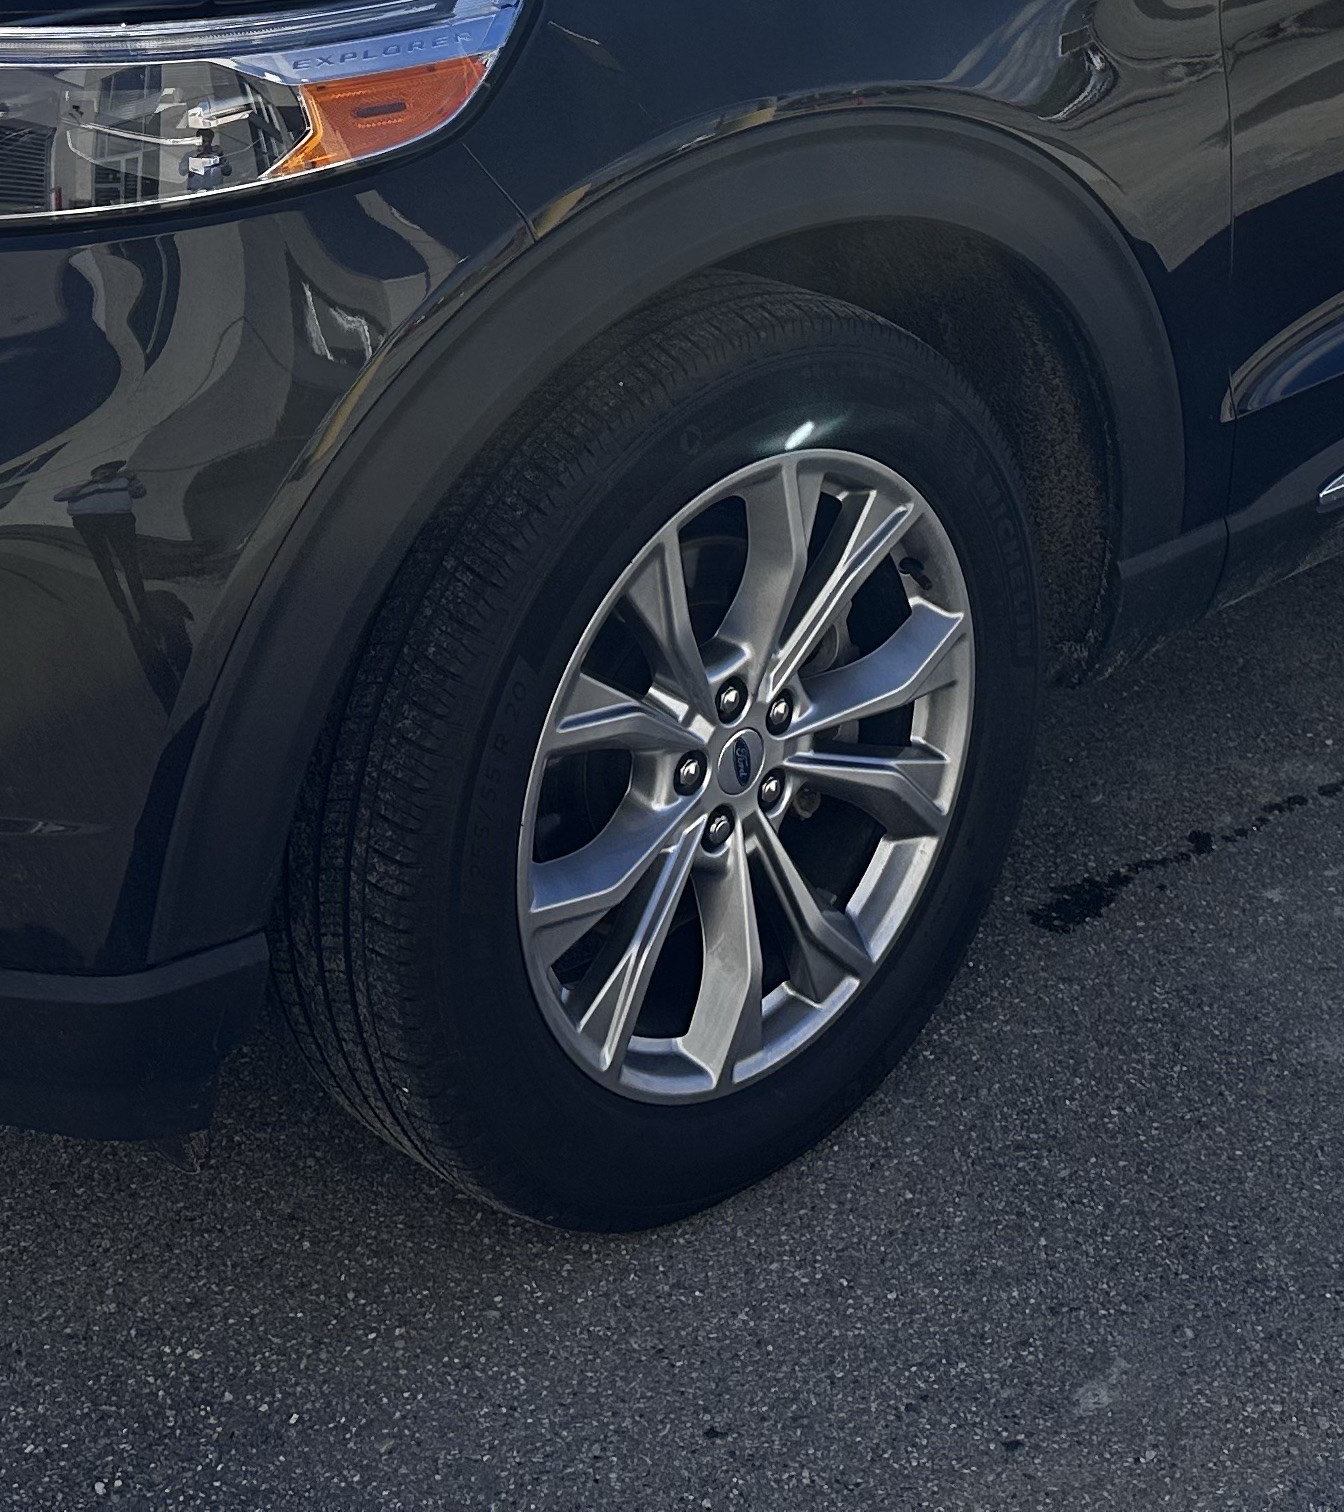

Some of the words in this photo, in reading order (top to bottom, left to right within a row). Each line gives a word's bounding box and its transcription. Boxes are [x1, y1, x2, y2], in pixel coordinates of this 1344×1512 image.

[292, 32, 472, 71] EXPLORER
[975, 472, 1032, 658] MICHELIN
[504, 680, 527, 724] 20
